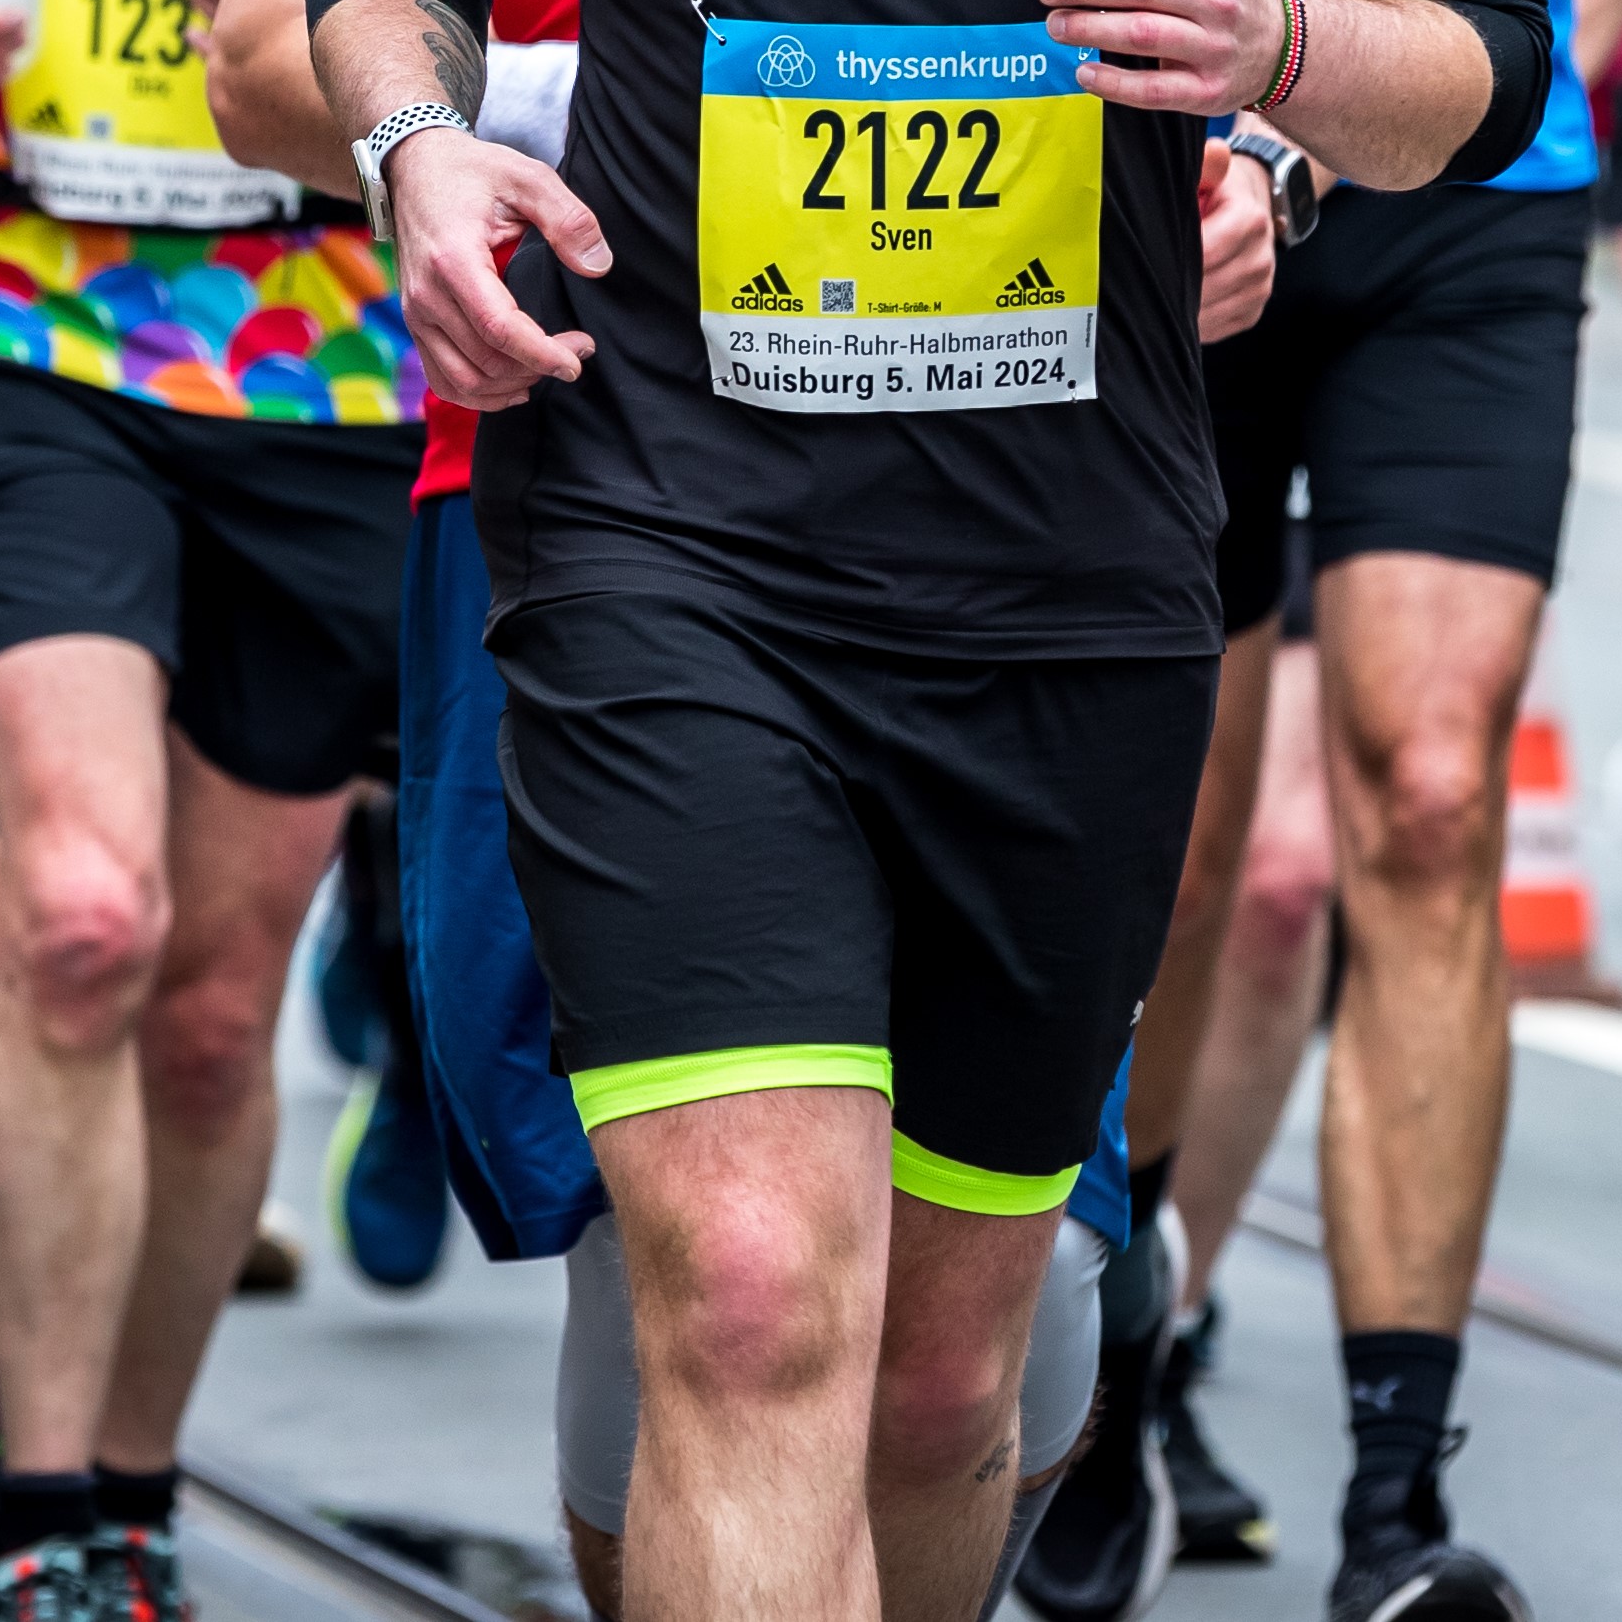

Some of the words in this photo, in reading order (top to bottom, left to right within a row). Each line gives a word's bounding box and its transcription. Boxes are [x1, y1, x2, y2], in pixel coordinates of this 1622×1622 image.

[836, 50, 1048, 85] thyssenkrupp
[802, 109, 1001, 211] 2122
[870, 220, 933, 251] Sven
[731, 294, 804, 313] adidas
[933, 301, 942, 312] M
[995, 288, 1066, 309] adidas
[729, 331, 760, 353] 23.
[767, 326, 1068, 357] Rhein-Ruhr-Halbmarathon
[731, 361, 875, 399] Duisburg
[886, 367, 913, 393] 5.
[926, 362, 984, 392] Mai
[994, 356, 1066, 389] 2024
